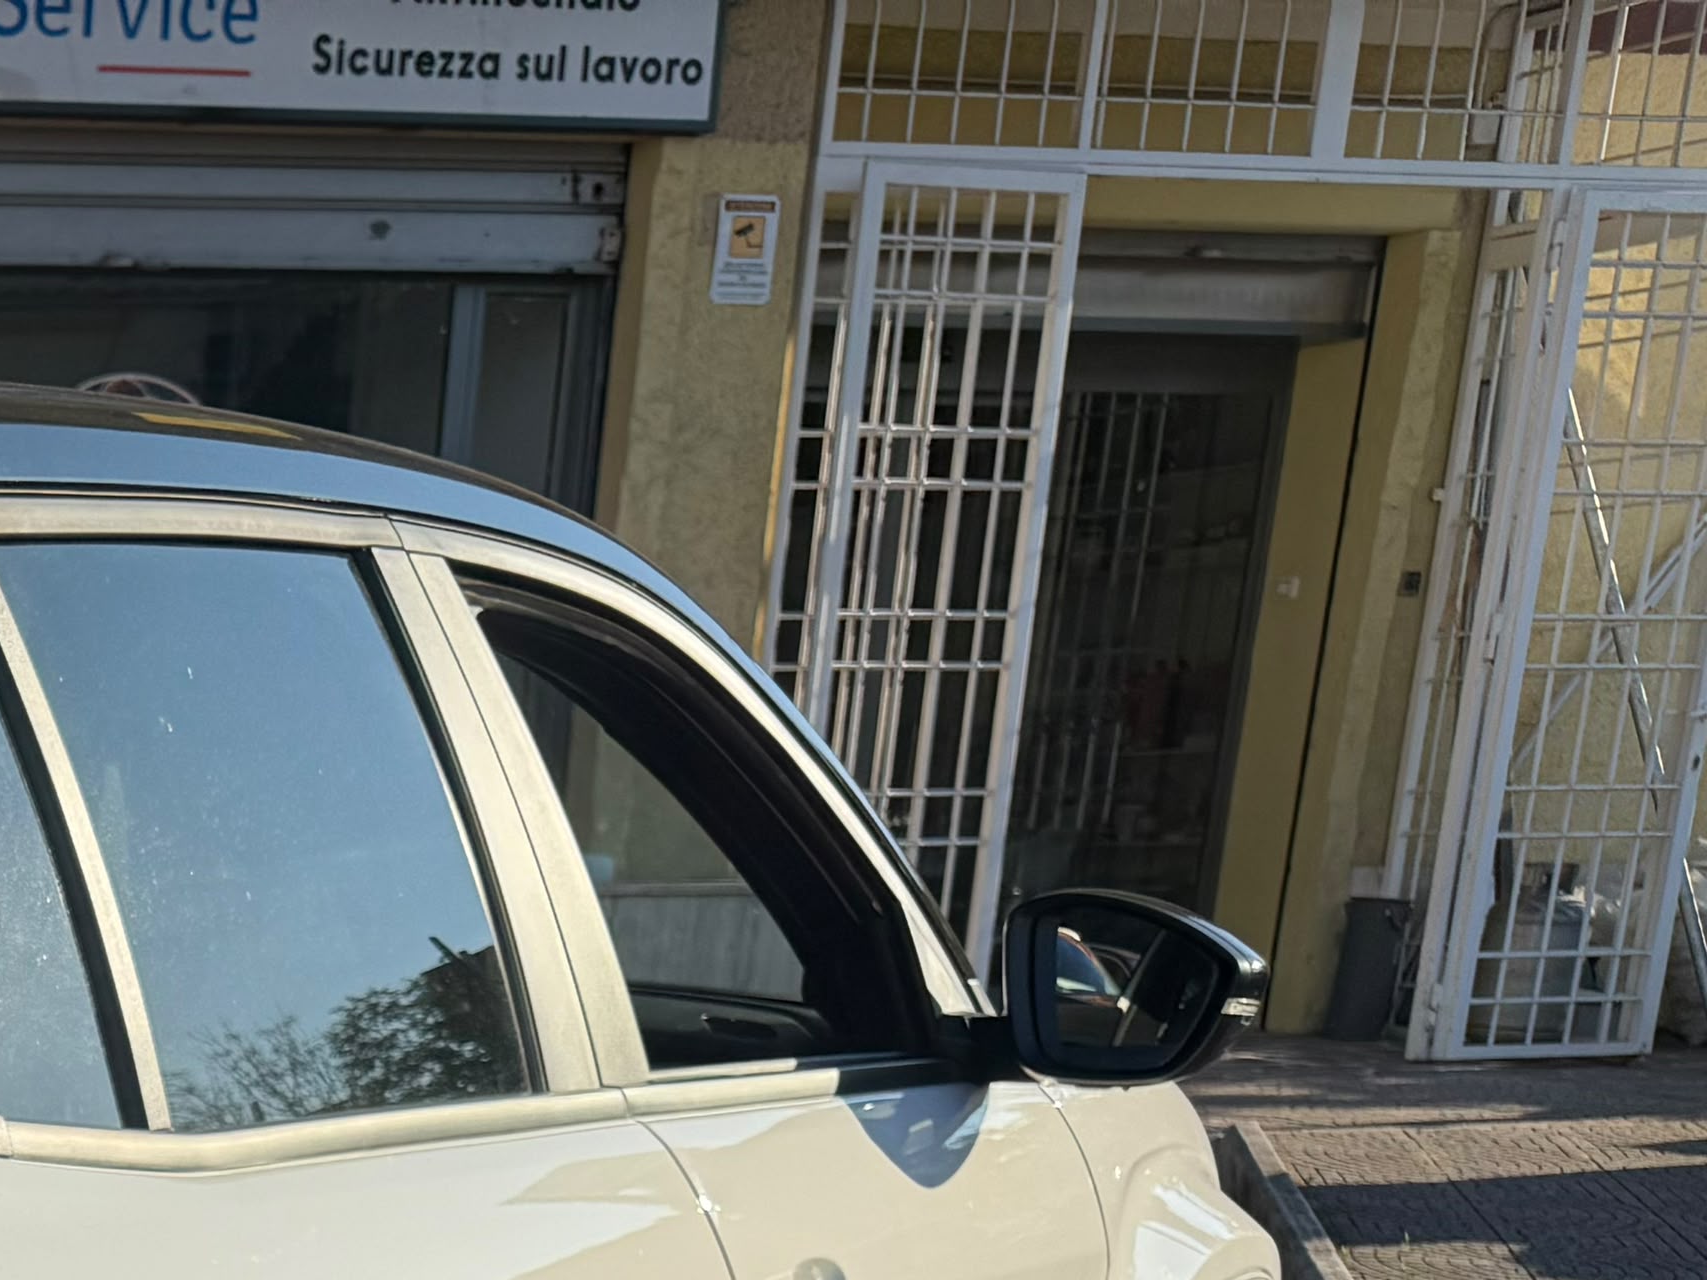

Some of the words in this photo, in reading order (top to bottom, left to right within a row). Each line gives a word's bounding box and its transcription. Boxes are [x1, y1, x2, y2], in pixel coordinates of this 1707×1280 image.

[311, 33, 502, 81] Sicurezza
[516, 44, 569, 82] sul
[580, 45, 704, 87] lavoro
